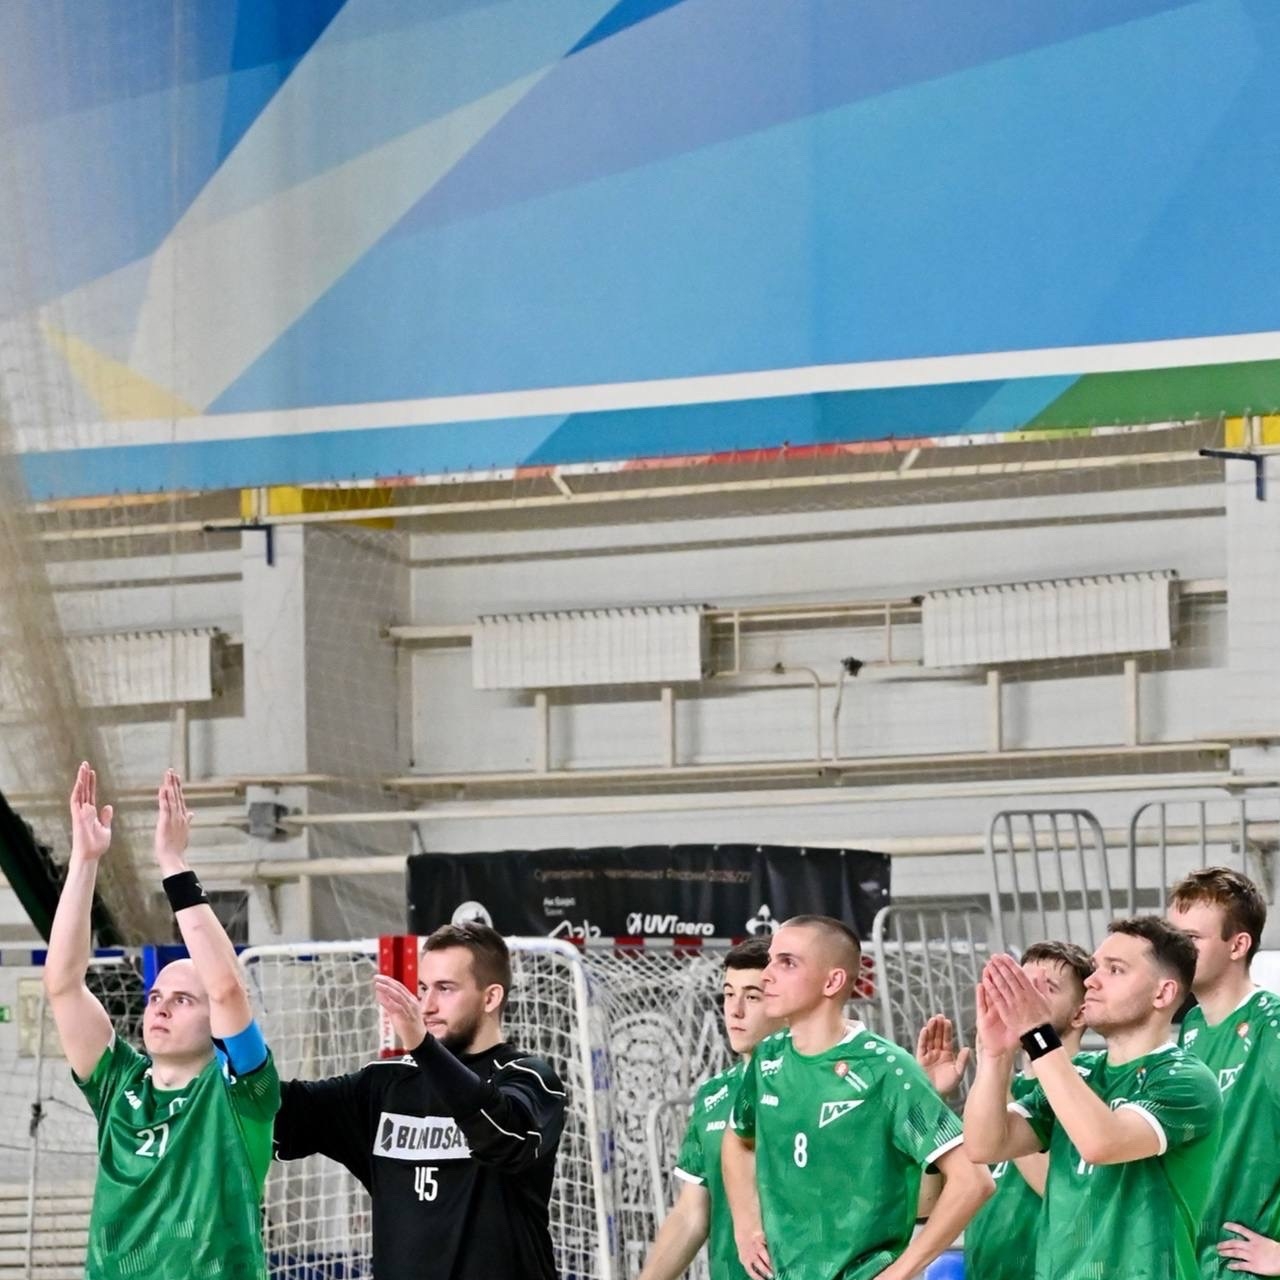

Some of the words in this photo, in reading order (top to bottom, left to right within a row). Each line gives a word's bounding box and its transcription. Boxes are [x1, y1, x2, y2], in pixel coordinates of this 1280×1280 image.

[644, 915, 715, 936] UVTaero
[135, 1123, 169, 1157] 27
[793, 1132, 808, 1168] 8
[414, 1166, 439, 1201] 45
